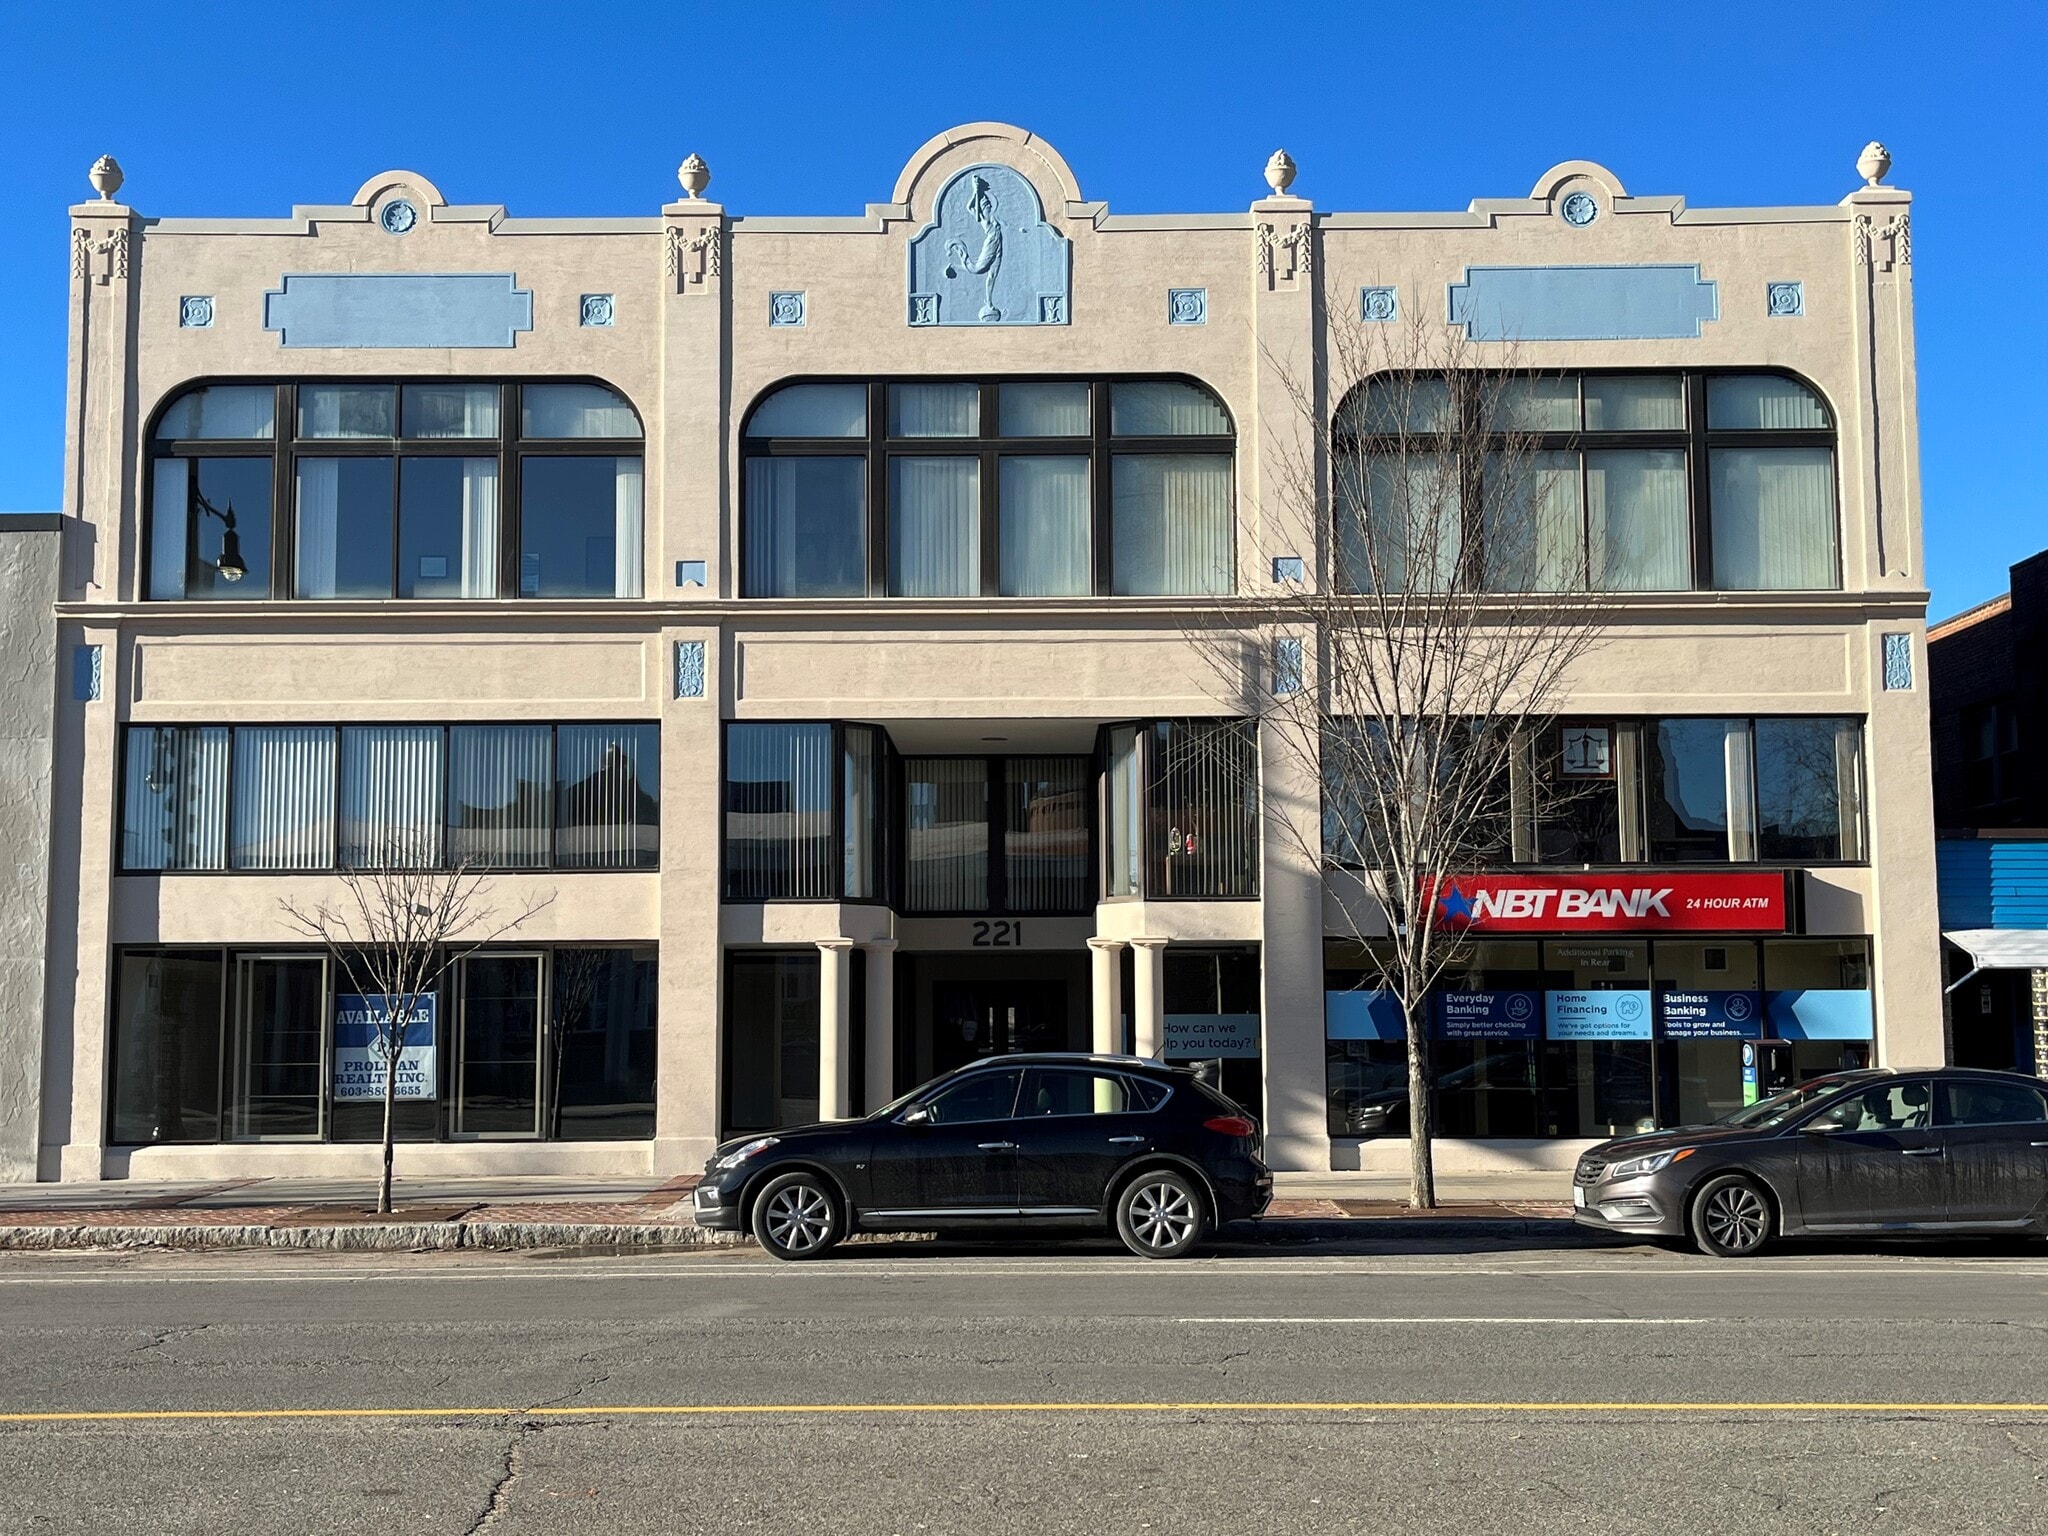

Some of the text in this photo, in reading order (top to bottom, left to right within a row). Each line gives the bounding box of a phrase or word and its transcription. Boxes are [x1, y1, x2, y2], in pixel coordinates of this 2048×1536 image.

[1471, 888, 1674, 918] NBT BANK
[1686, 897, 1769, 909] 24 HOUR ATM
[972, 920, 1021, 947] 221
[1557, 948, 1634, 958] Additional Parking
[1590, 958, 1610, 966] Rear
[1446, 993, 1495, 1004] Everyday
[1556, 994, 1587, 1003] Home
[1663, 993, 1709, 1003] Business
[1446, 1005, 1489, 1016] Banking
[1557, 1005, 1607, 1015] Financing
[1663, 1006, 1707, 1016] Banking
[1192, 1024, 1215, 1033] can
[1218, 1024, 1236, 1033] we
[1494, 1021, 1526, 1029] checking
[1182, 1040, 1205, 1050] you
[1208, 1037, 1251, 1050] today?
[398, 1072, 428, 1083] INC.
